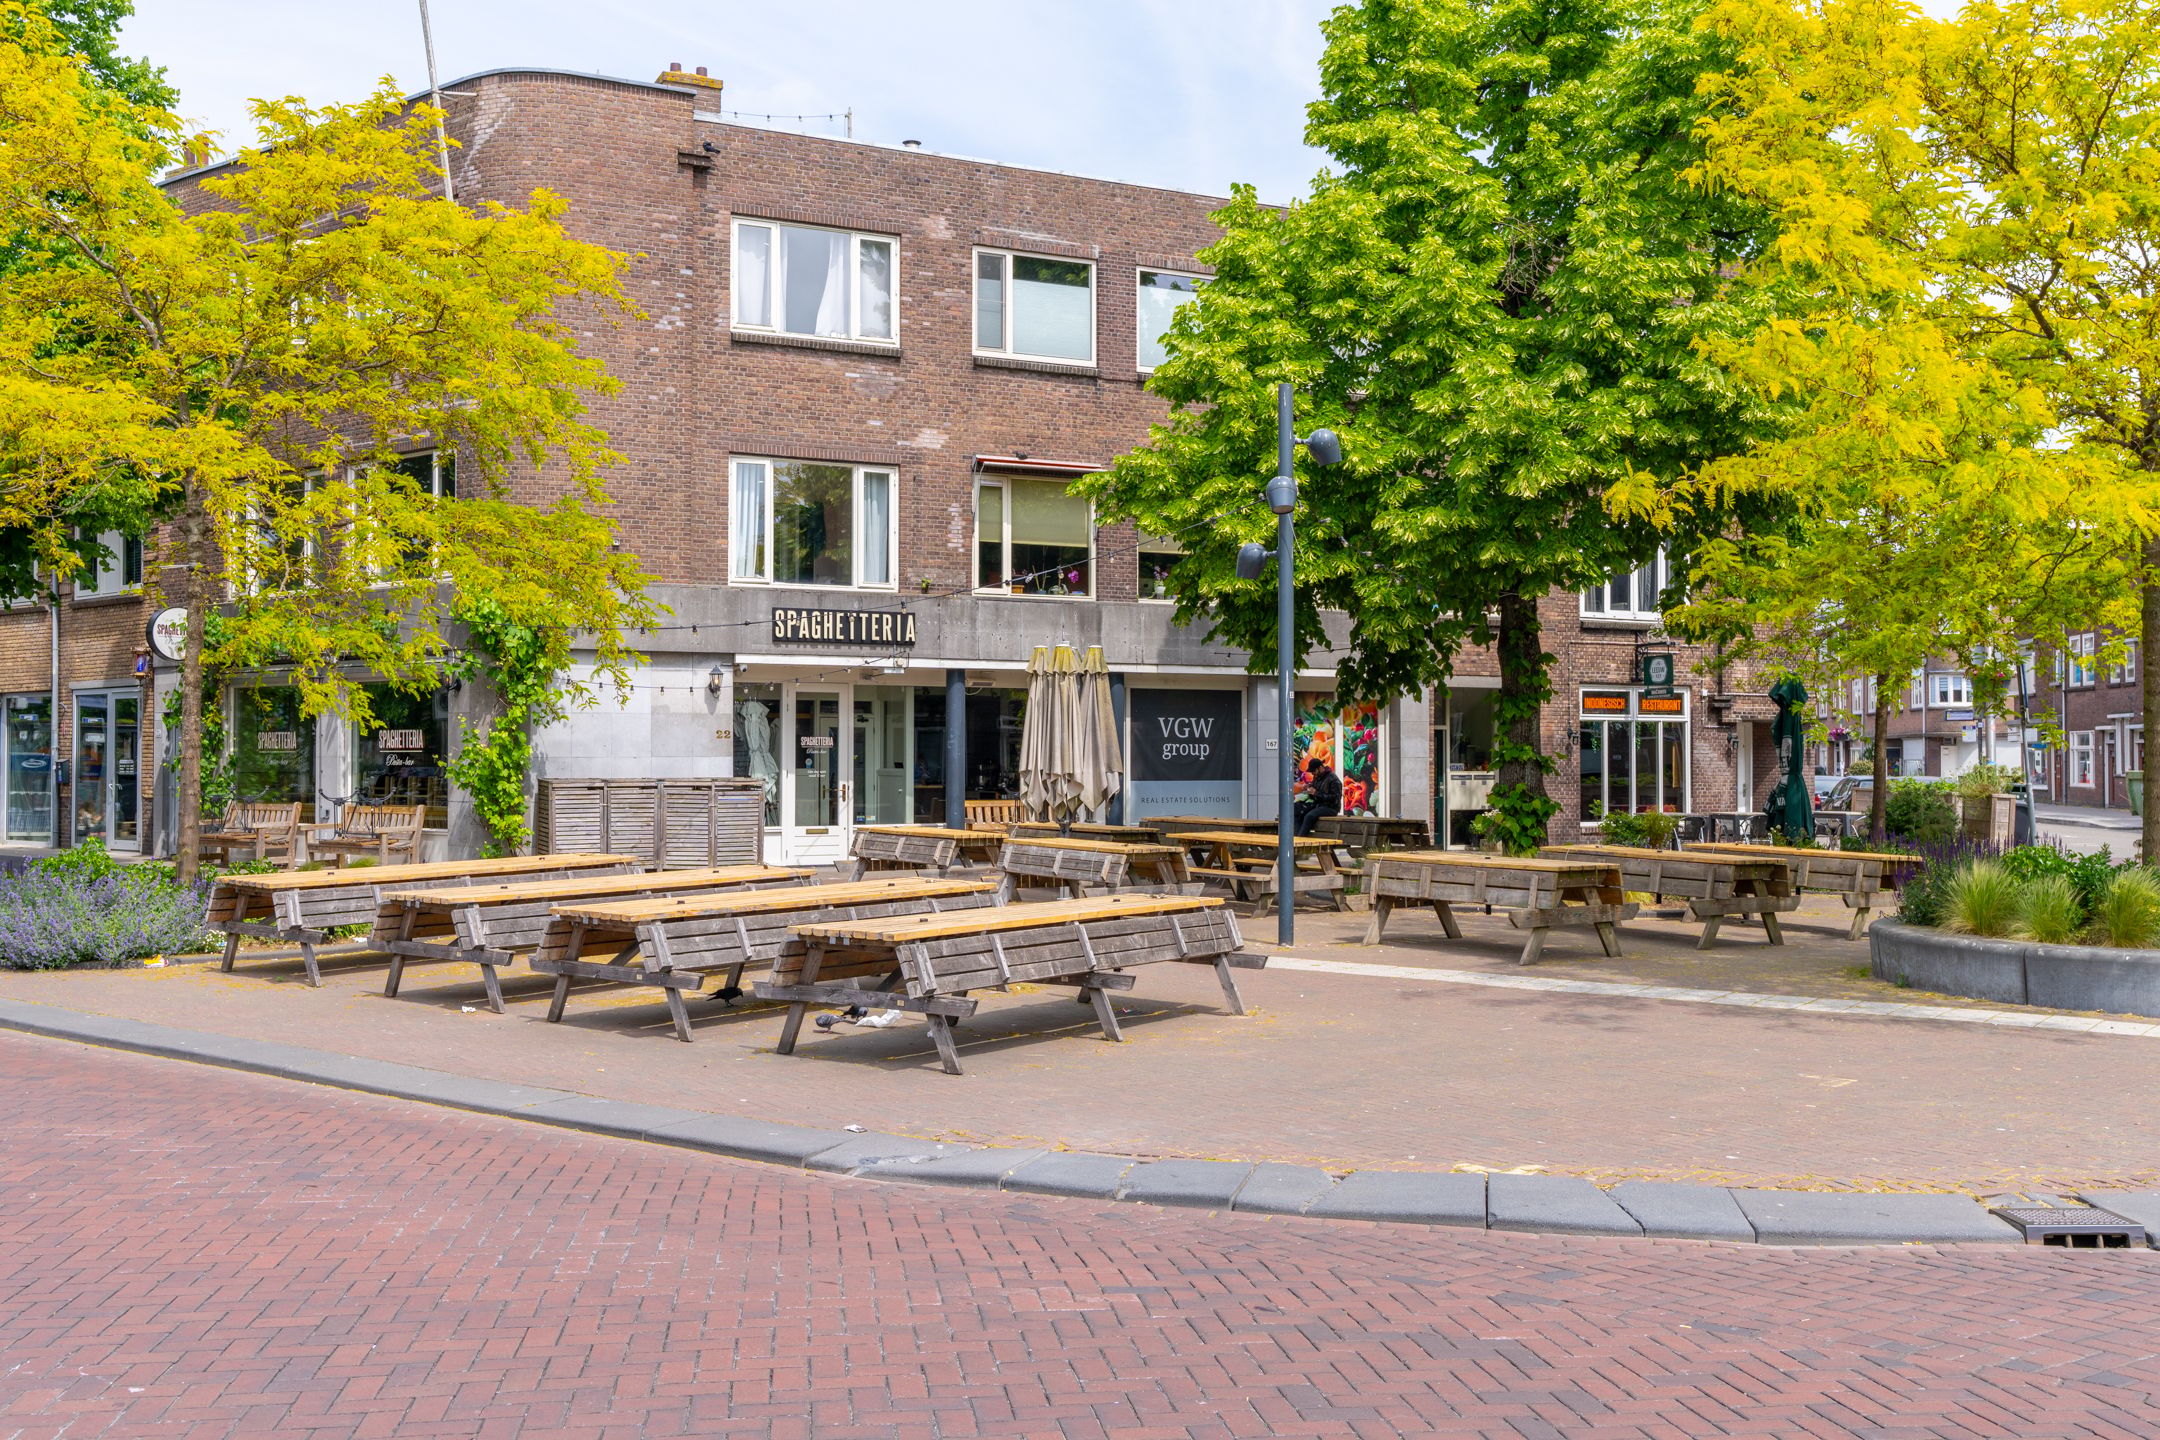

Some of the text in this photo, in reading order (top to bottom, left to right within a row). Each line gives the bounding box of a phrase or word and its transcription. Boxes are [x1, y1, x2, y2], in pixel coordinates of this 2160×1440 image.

[775, 609, 916, 642] SPAGHETTERIA
[1584, 697, 1626, 710] INDONESISCH
[1641, 699, 1681, 711] RESTAURANT
[716, 730, 731, 739] 22
[1158, 717, 1214, 738] VGW
[257, 731, 297, 750] SPAGHETTERIA
[378, 729, 424, 749] SPAGHETTERIA
[800, 736, 834, 747] SPAGHETTERIA
[1162, 743, 1210, 760] group
[385, 753, 415, 767] Pasta-bar
